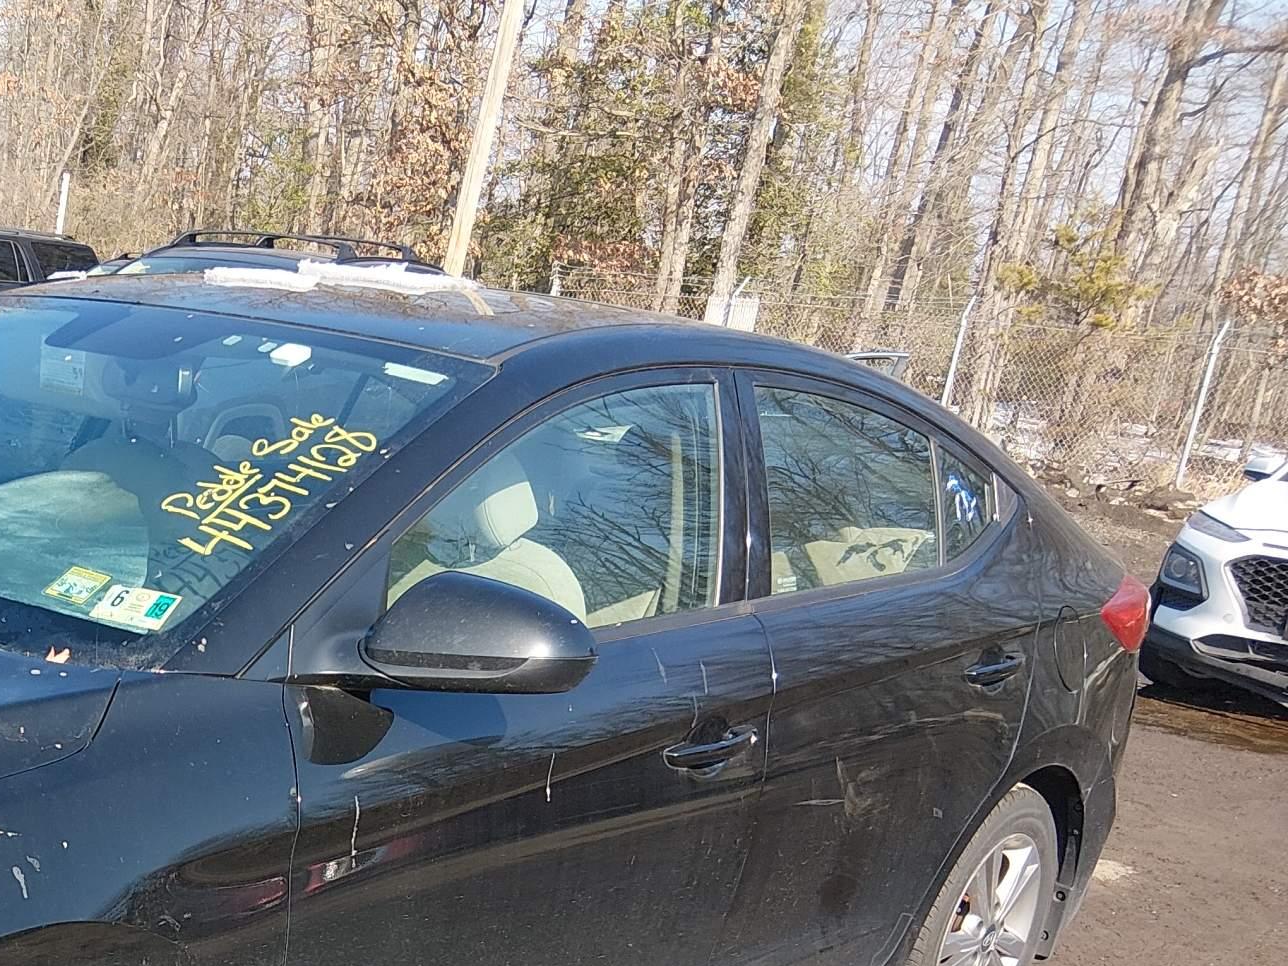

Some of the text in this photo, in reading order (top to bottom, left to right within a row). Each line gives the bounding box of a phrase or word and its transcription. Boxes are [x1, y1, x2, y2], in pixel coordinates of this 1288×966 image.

[251, 413, 335, 457] Sale
[177, 425, 378, 556] 44374128
[110, 589, 130, 608] 6
[146, 600, 172, 618] 19
